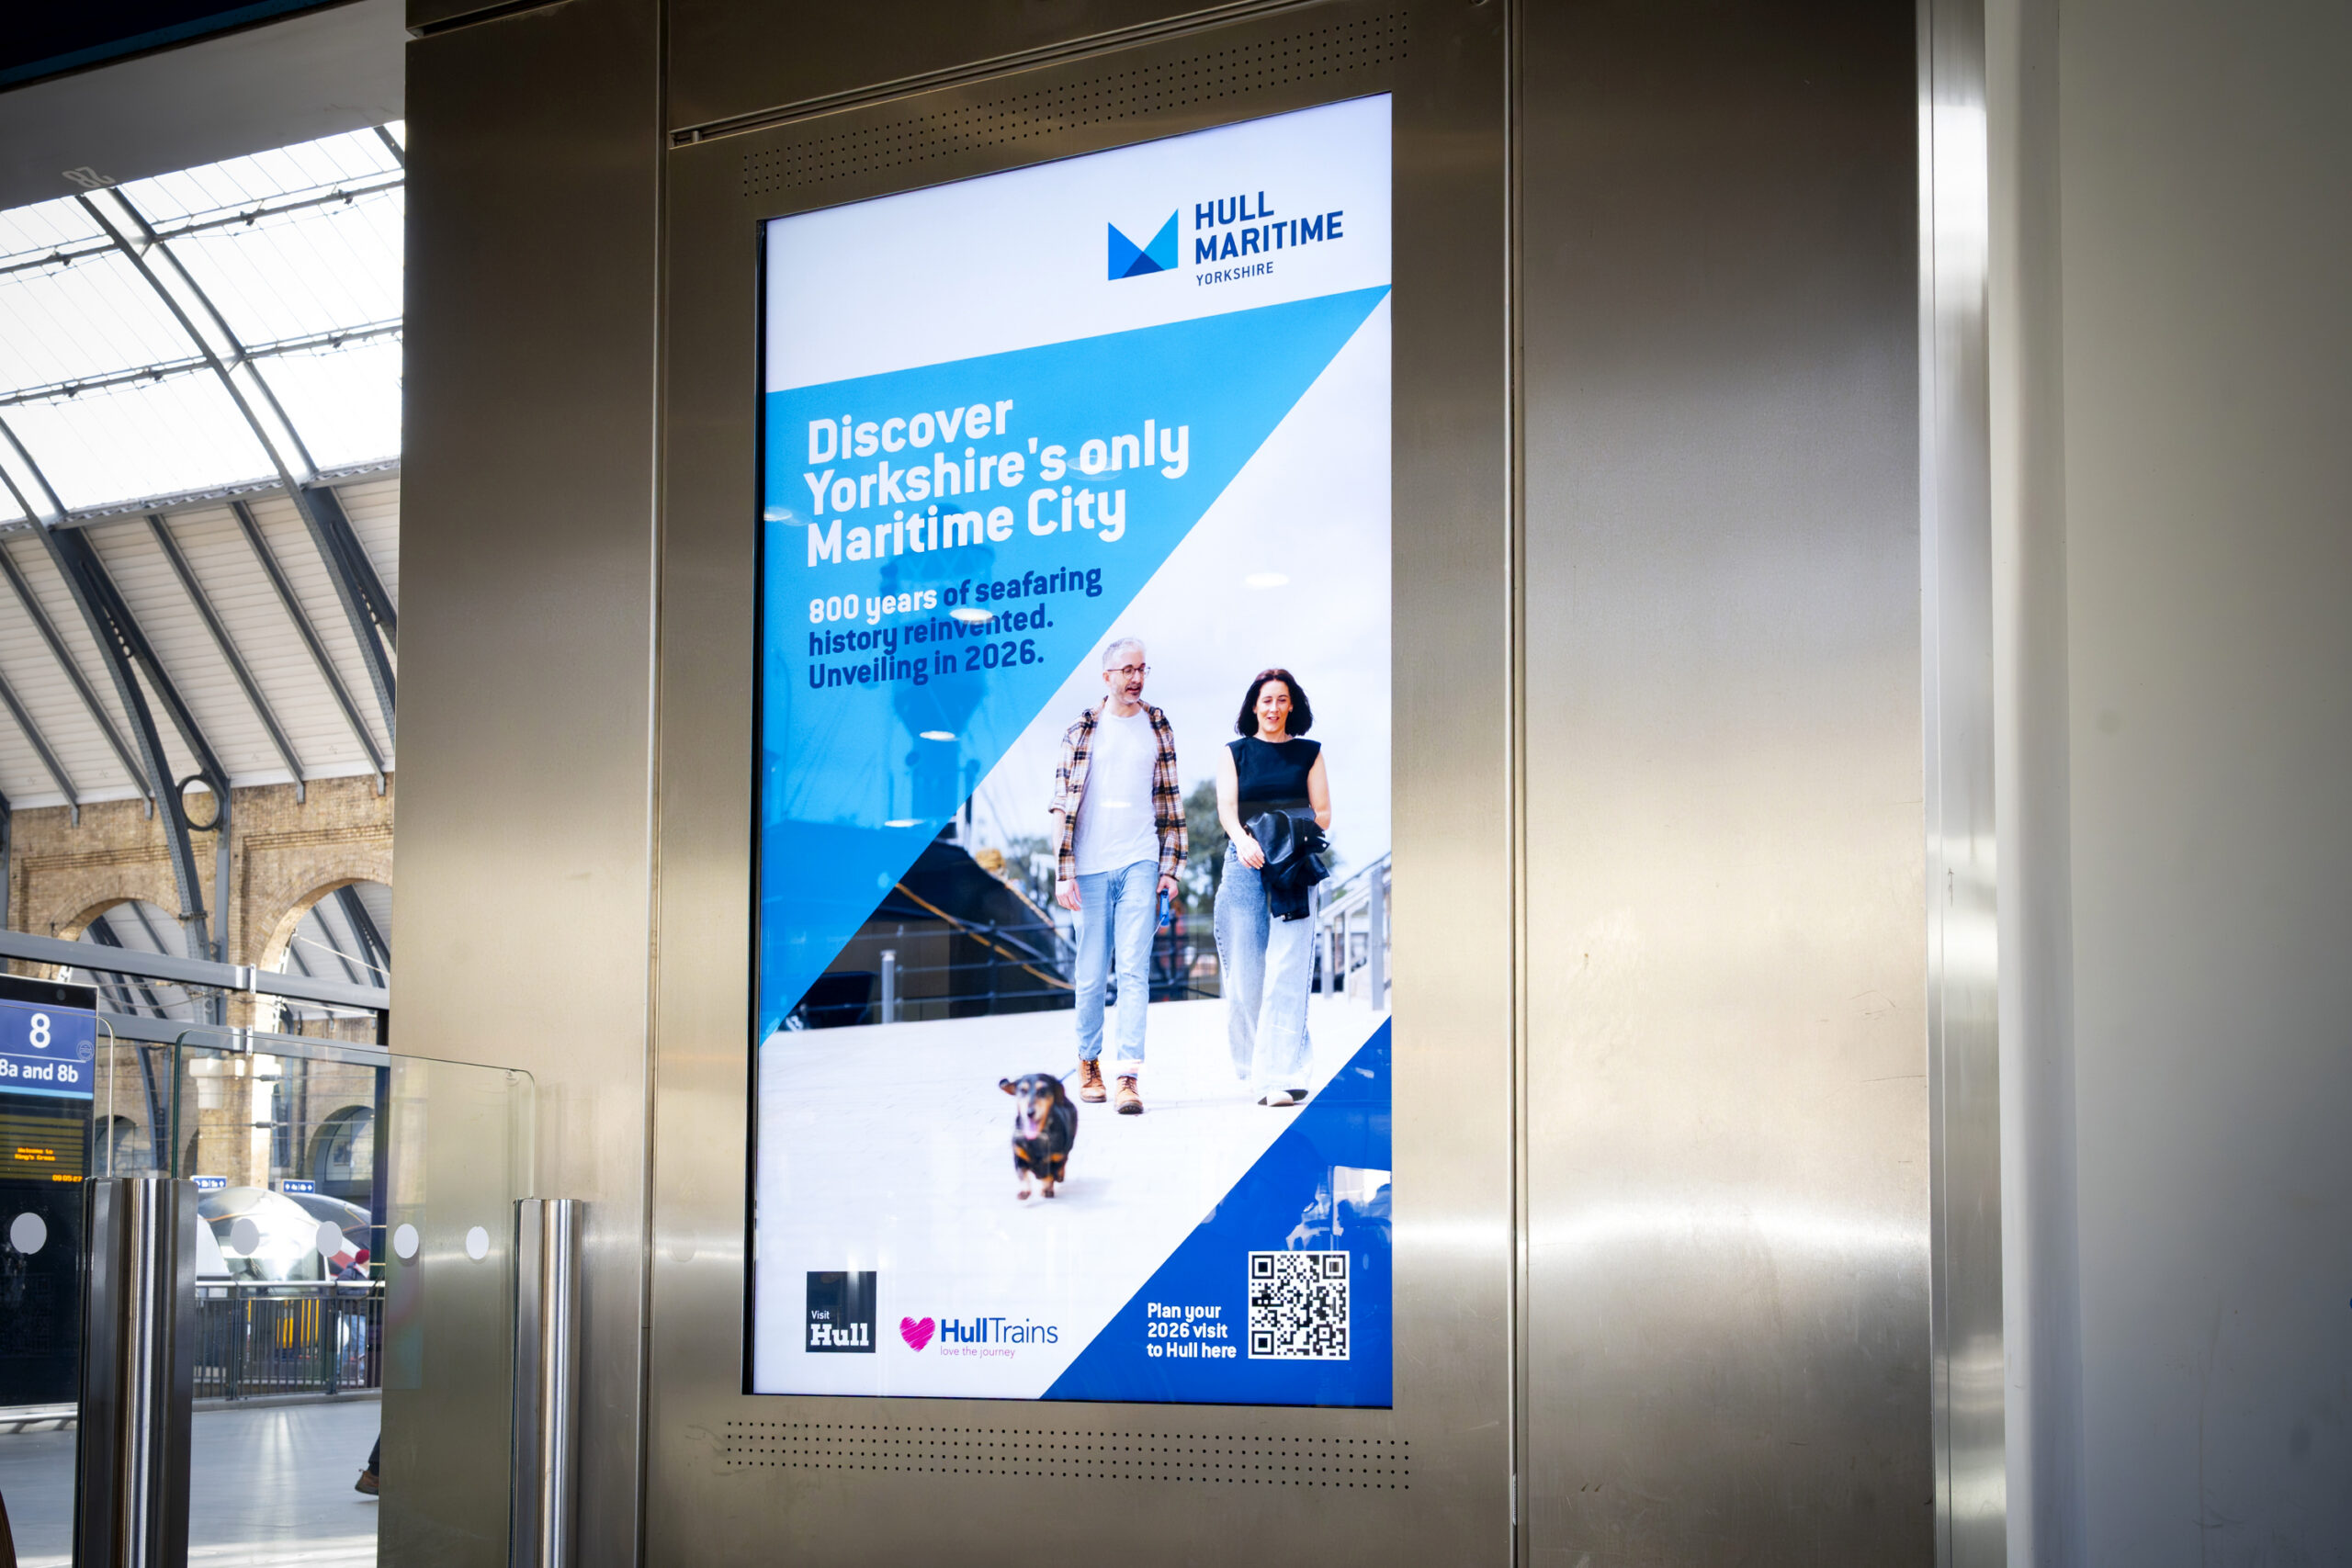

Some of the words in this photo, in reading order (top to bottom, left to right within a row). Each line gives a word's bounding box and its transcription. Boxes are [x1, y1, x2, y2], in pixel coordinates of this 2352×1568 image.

[1195, 190, 1274, 230] HULL
[1195, 210, 1343, 265] MARITIME
[1196, 261, 1273, 287] YORKSHIRE
[808, 399, 1013, 465] Discover
[804, 437, 1067, 515] Yorkshire's
[1080, 419, 1190, 479] only
[808, 502, 1013, 568] Maritime
[1027, 485, 1126, 543] City
[809, 593, 859, 624] 800
[865, 588, 938, 626] years
[944, 580, 971, 606] of
[976, 566, 1103, 600] seafaring
[809, 626, 898, 657] history
[904, 604, 1054, 644] reinvented.
[809, 654, 928, 689] Unveiling
[934, 649, 957, 675] in
[965, 638, 1044, 671] 2026.
[29, 1012, 51, 1048] 8
[0, 1058, 18, 1077] 8a
[22, 1063, 53, 1081] and
[57, 1065, 78, 1083] 8b
[811, 1310, 830, 1320] Visit
[1148, 1303, 1181, 1318] Plan
[1184, 1305, 1221, 1323] your
[810, 1323, 869, 1346] Hull
[941, 1317, 1058, 1344] HullTrains
[1148, 1322, 1190, 1338] 2026
[1193, 1323, 1227, 1338] visit
[940, 1346, 959, 1356] love
[962, 1347, 978, 1356] the
[979, 1347, 1015, 1359] journey
[1147, 1342, 1163, 1358] to
[1167, 1342, 1198, 1358] Hull
[1202, 1342, 1238, 1359] here
